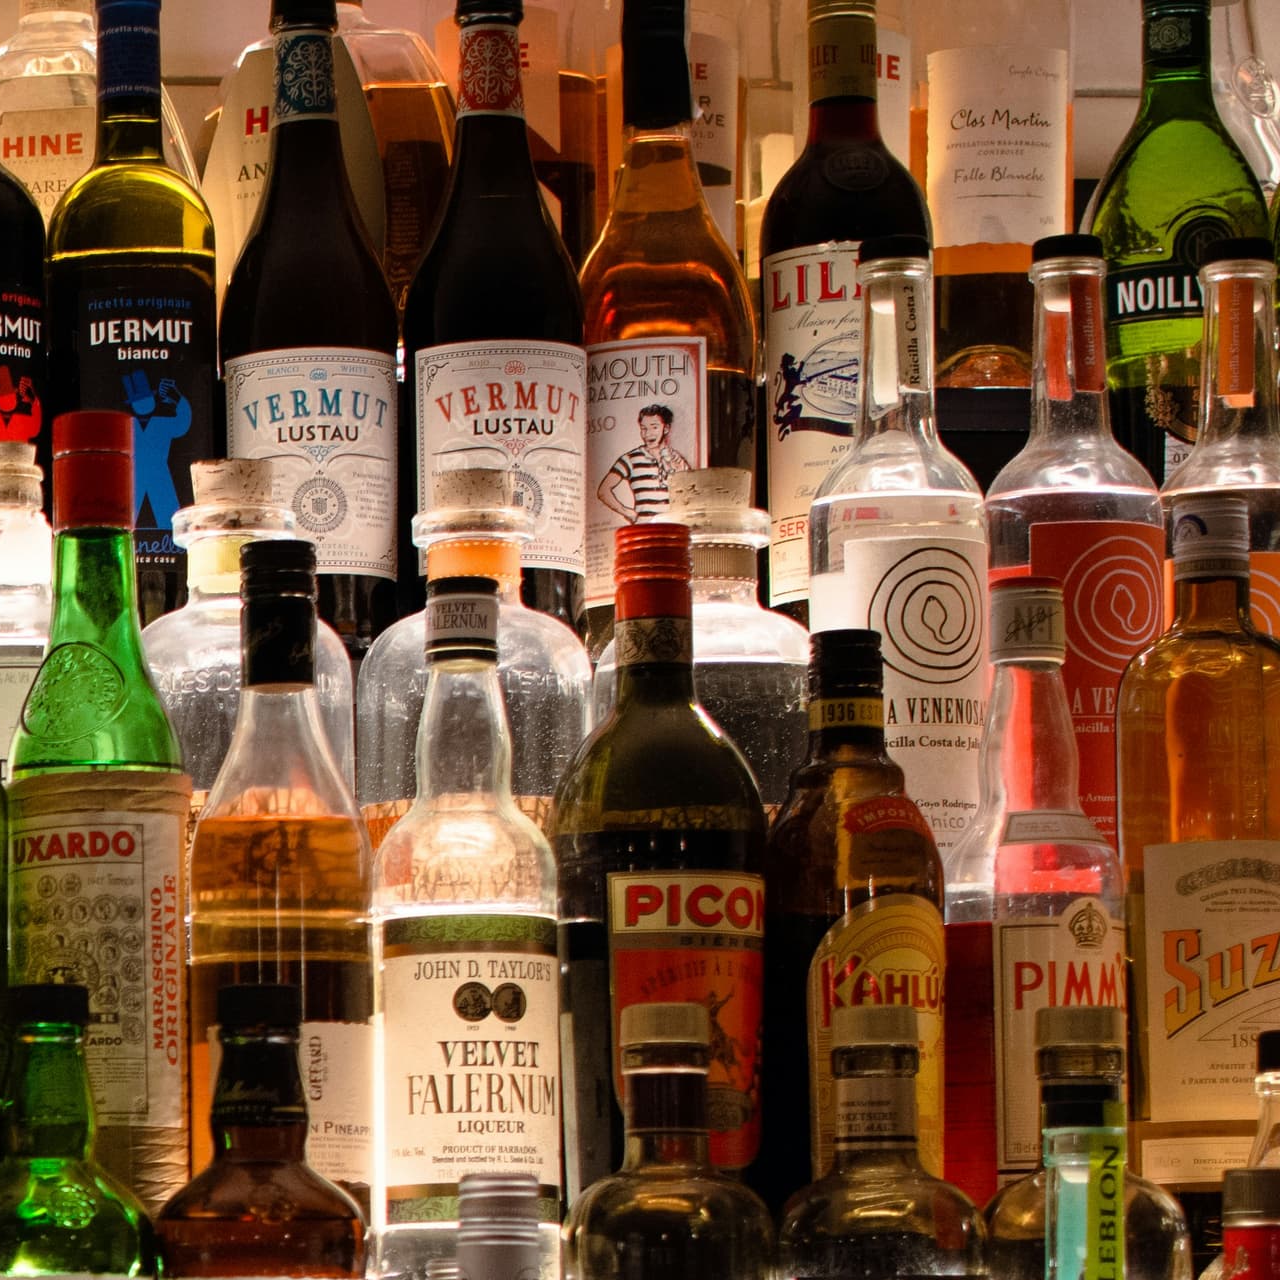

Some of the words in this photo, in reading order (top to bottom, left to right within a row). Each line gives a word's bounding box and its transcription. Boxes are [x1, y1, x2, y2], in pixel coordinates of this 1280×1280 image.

[951, 108, 986, 132] Clos
[991, 109, 1053, 129] Martin
[2, 133, 83, 158] HINE
[88, 298, 131, 312] ricetta
[135, 296, 192, 309] originale
[906, 297, 919, 331] Costa
[89, 319, 193, 347] VERMUT
[117, 346, 169, 360] bianco
[909, 335, 920, 385] Raicilla
[243, 389, 388, 430] VERMUT
[435, 381, 579, 423] VERMUT
[277, 425, 359, 443] LUSTAU
[473, 418, 554, 436] LUSTAU
[821, 701, 855, 722] 1936
[907, 697, 985, 725] VENENOSA
[919, 736, 953, 748] Costa
[955, 737, 966, 748] de
[14, 829, 136, 866] UXARDO
[152, 886, 164, 1050] MARASCHINO
[164, 875, 180, 1066] ORIGINALE
[414, 960, 461, 981] JOHN
[466, 960, 482, 979] D.
[437, 1040, 539, 1069] VELVET
[408, 1072, 557, 1117] FALERNUM
[458, 1119, 526, 1136] LIQUEUR
[442, 1144, 483, 1155] PRODUCT
[485, 1144, 495, 1155] OF
[497, 1144, 537, 1155] BARBADOS
